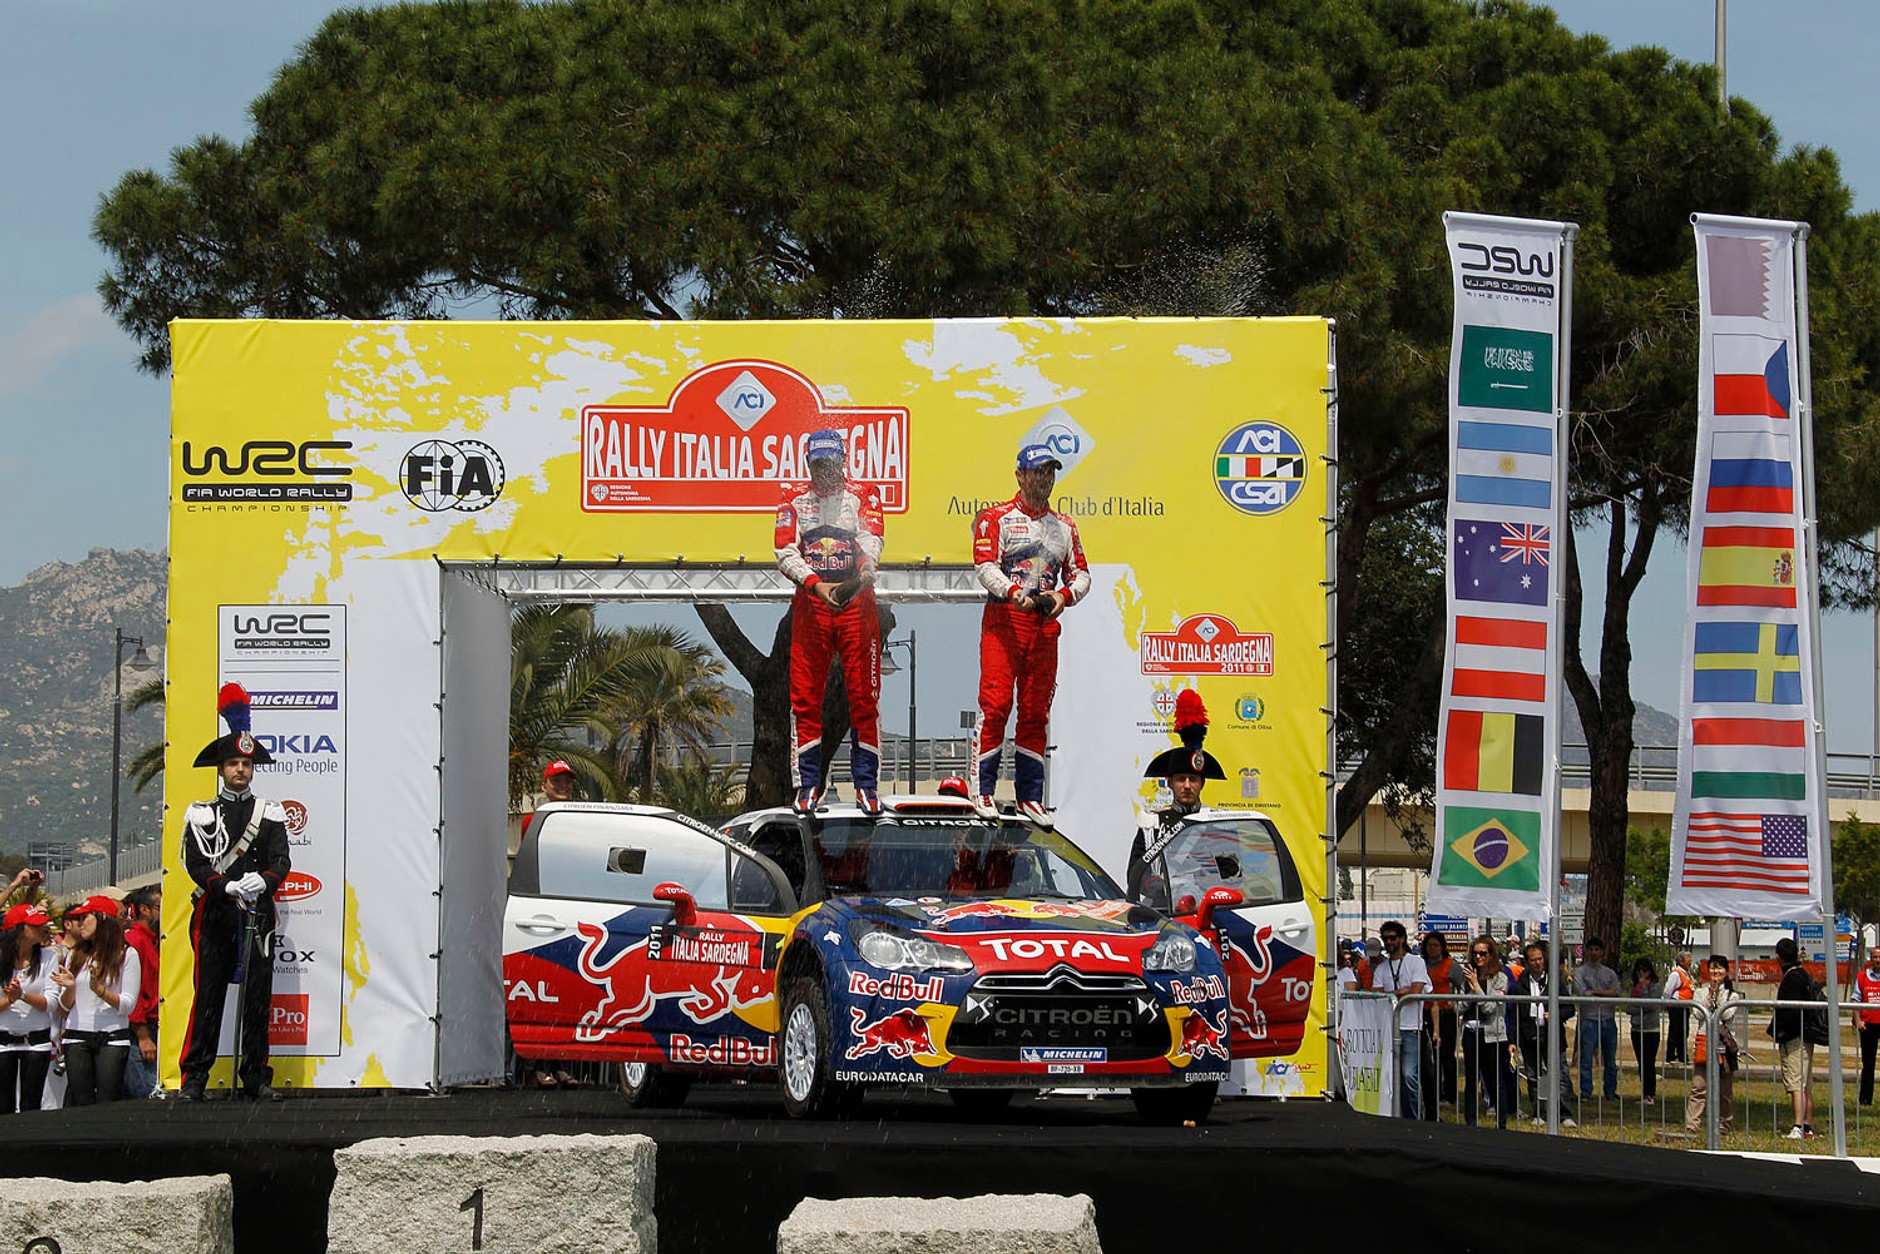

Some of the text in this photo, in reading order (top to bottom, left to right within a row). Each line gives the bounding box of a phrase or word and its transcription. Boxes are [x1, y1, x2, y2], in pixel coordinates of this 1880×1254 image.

[734, 393, 764, 409] ACI
[589, 414, 667, 478] RALLY
[673, 431, 755, 479] ITALIA
[1235, 430, 1281, 453] ACI
[183, 441, 353, 475] WRC
[187, 488, 348, 498] FIA WORLD RALLY
[187, 504, 347, 512] CHAMPIONSHIP
[1057, 496, 1098, 516] Club
[1102, 495, 1165, 516] d'Italia
[235, 614, 330, 633] WRC
[1144, 635, 1270, 662] RALLY ITALIA SARDEGNA
[1221, 663, 1245, 673] 2011
[250, 695, 335, 705] MICHELIN
[254, 735, 337, 753] OKIA
[296, 758, 338, 775] People
[648, 925, 663, 960] 2011
[699, 931, 724, 942] RALLY
[1219, 928, 1230, 960] 2011
[671, 935, 749, 965] ITALIA SARDEGNA
[979, 938, 1131, 962] TOTAL
[1042, 1050, 1103, 1060] MICHELIN
[836, 1070, 924, 1083] EURODATACAR
[459, 1187, 484, 1251] 1
